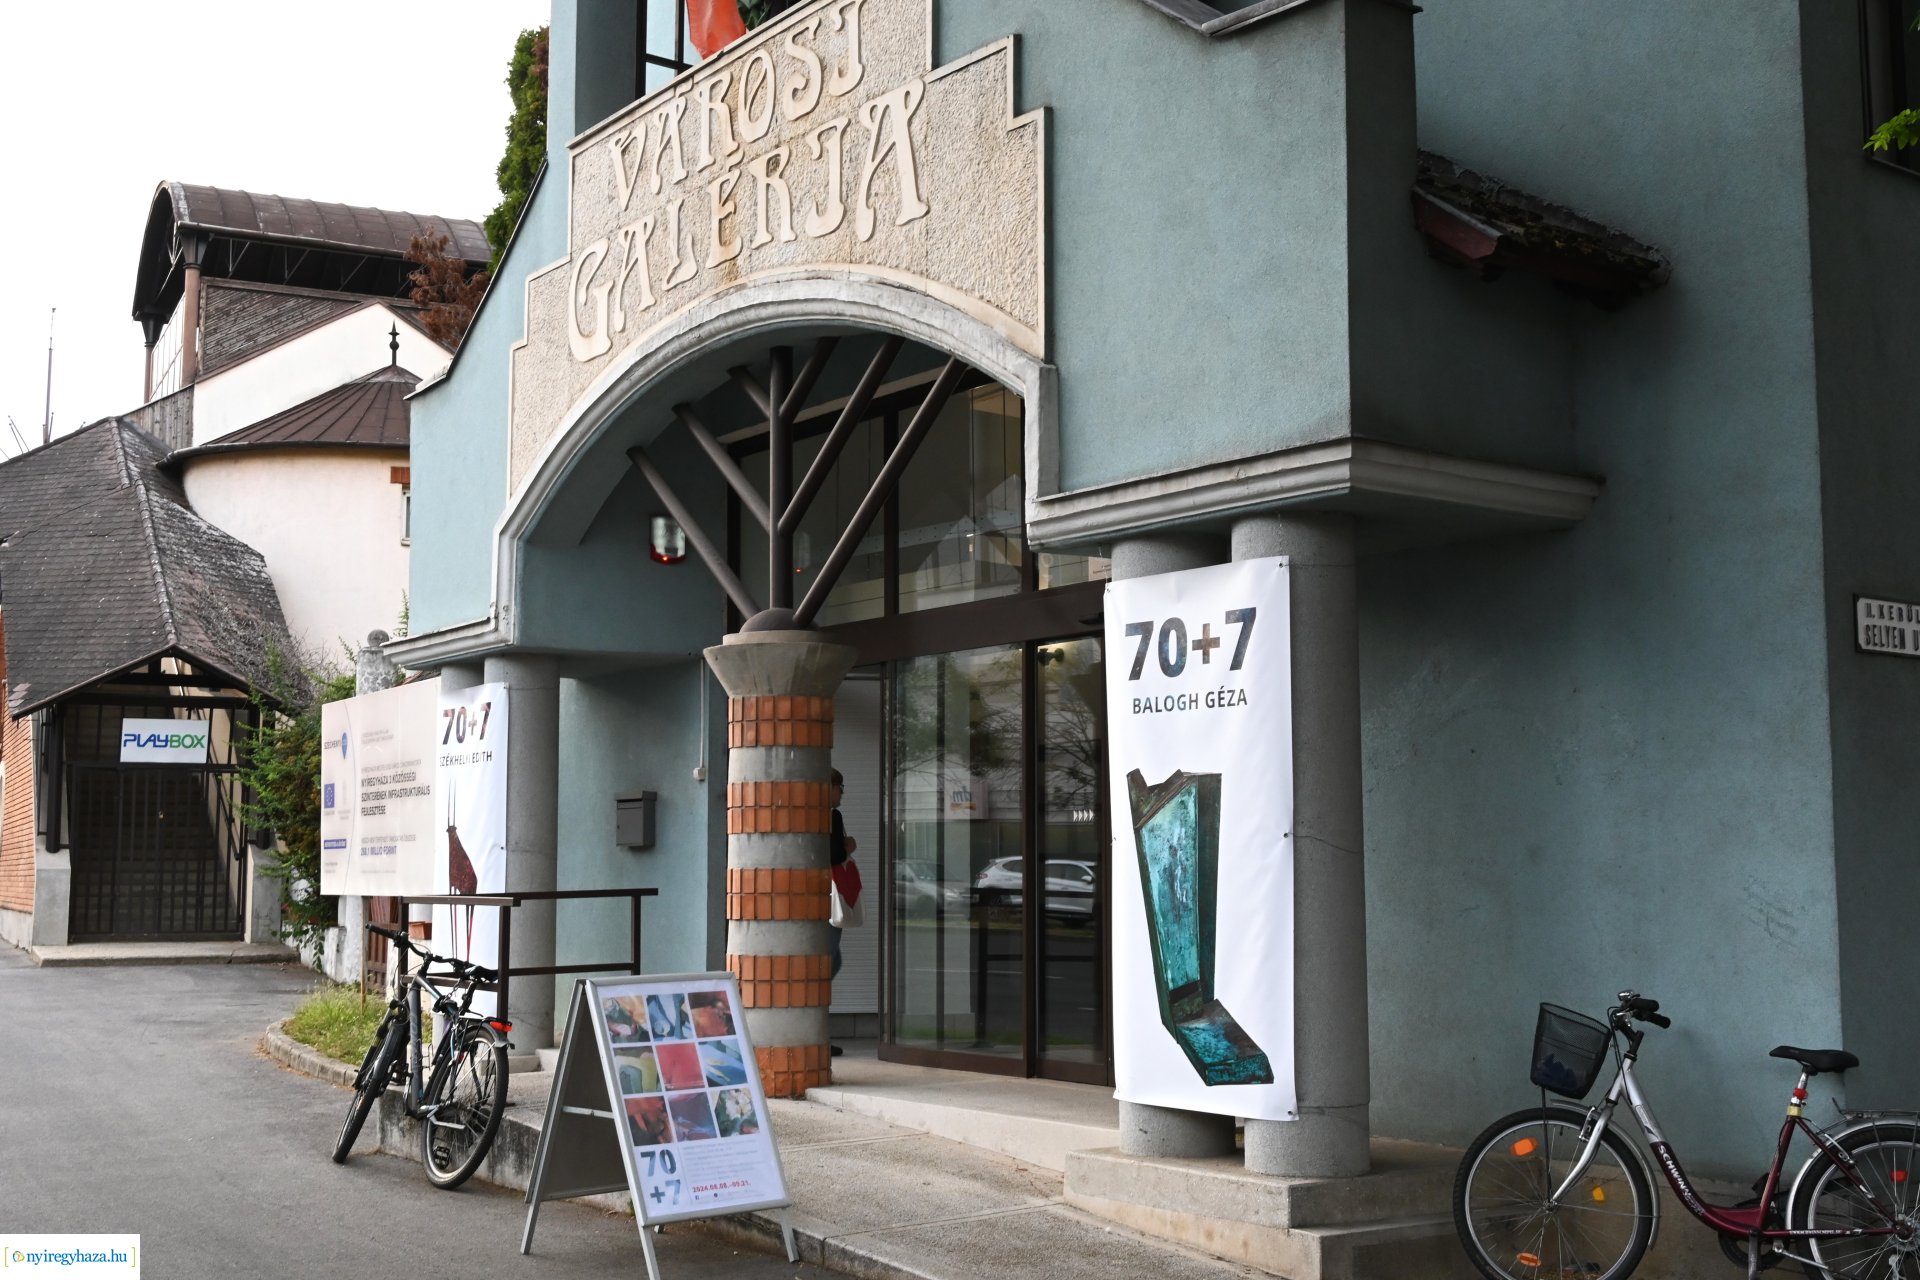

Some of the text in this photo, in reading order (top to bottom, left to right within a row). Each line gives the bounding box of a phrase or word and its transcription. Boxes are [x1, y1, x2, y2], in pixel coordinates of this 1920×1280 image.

[1125, 607, 1257, 681] 70+7
[1864, 624, 1906, 649] SELYEM
[1133, 686, 1248, 715] BALOGH GÉZA
[442, 701, 492, 745] 70+7
[123, 733, 206, 748] PLAYBOX
[472, 751, 493, 764] EDITH
[640, 1149, 677, 1177] 70
[650, 1179, 681, 1205] +7
